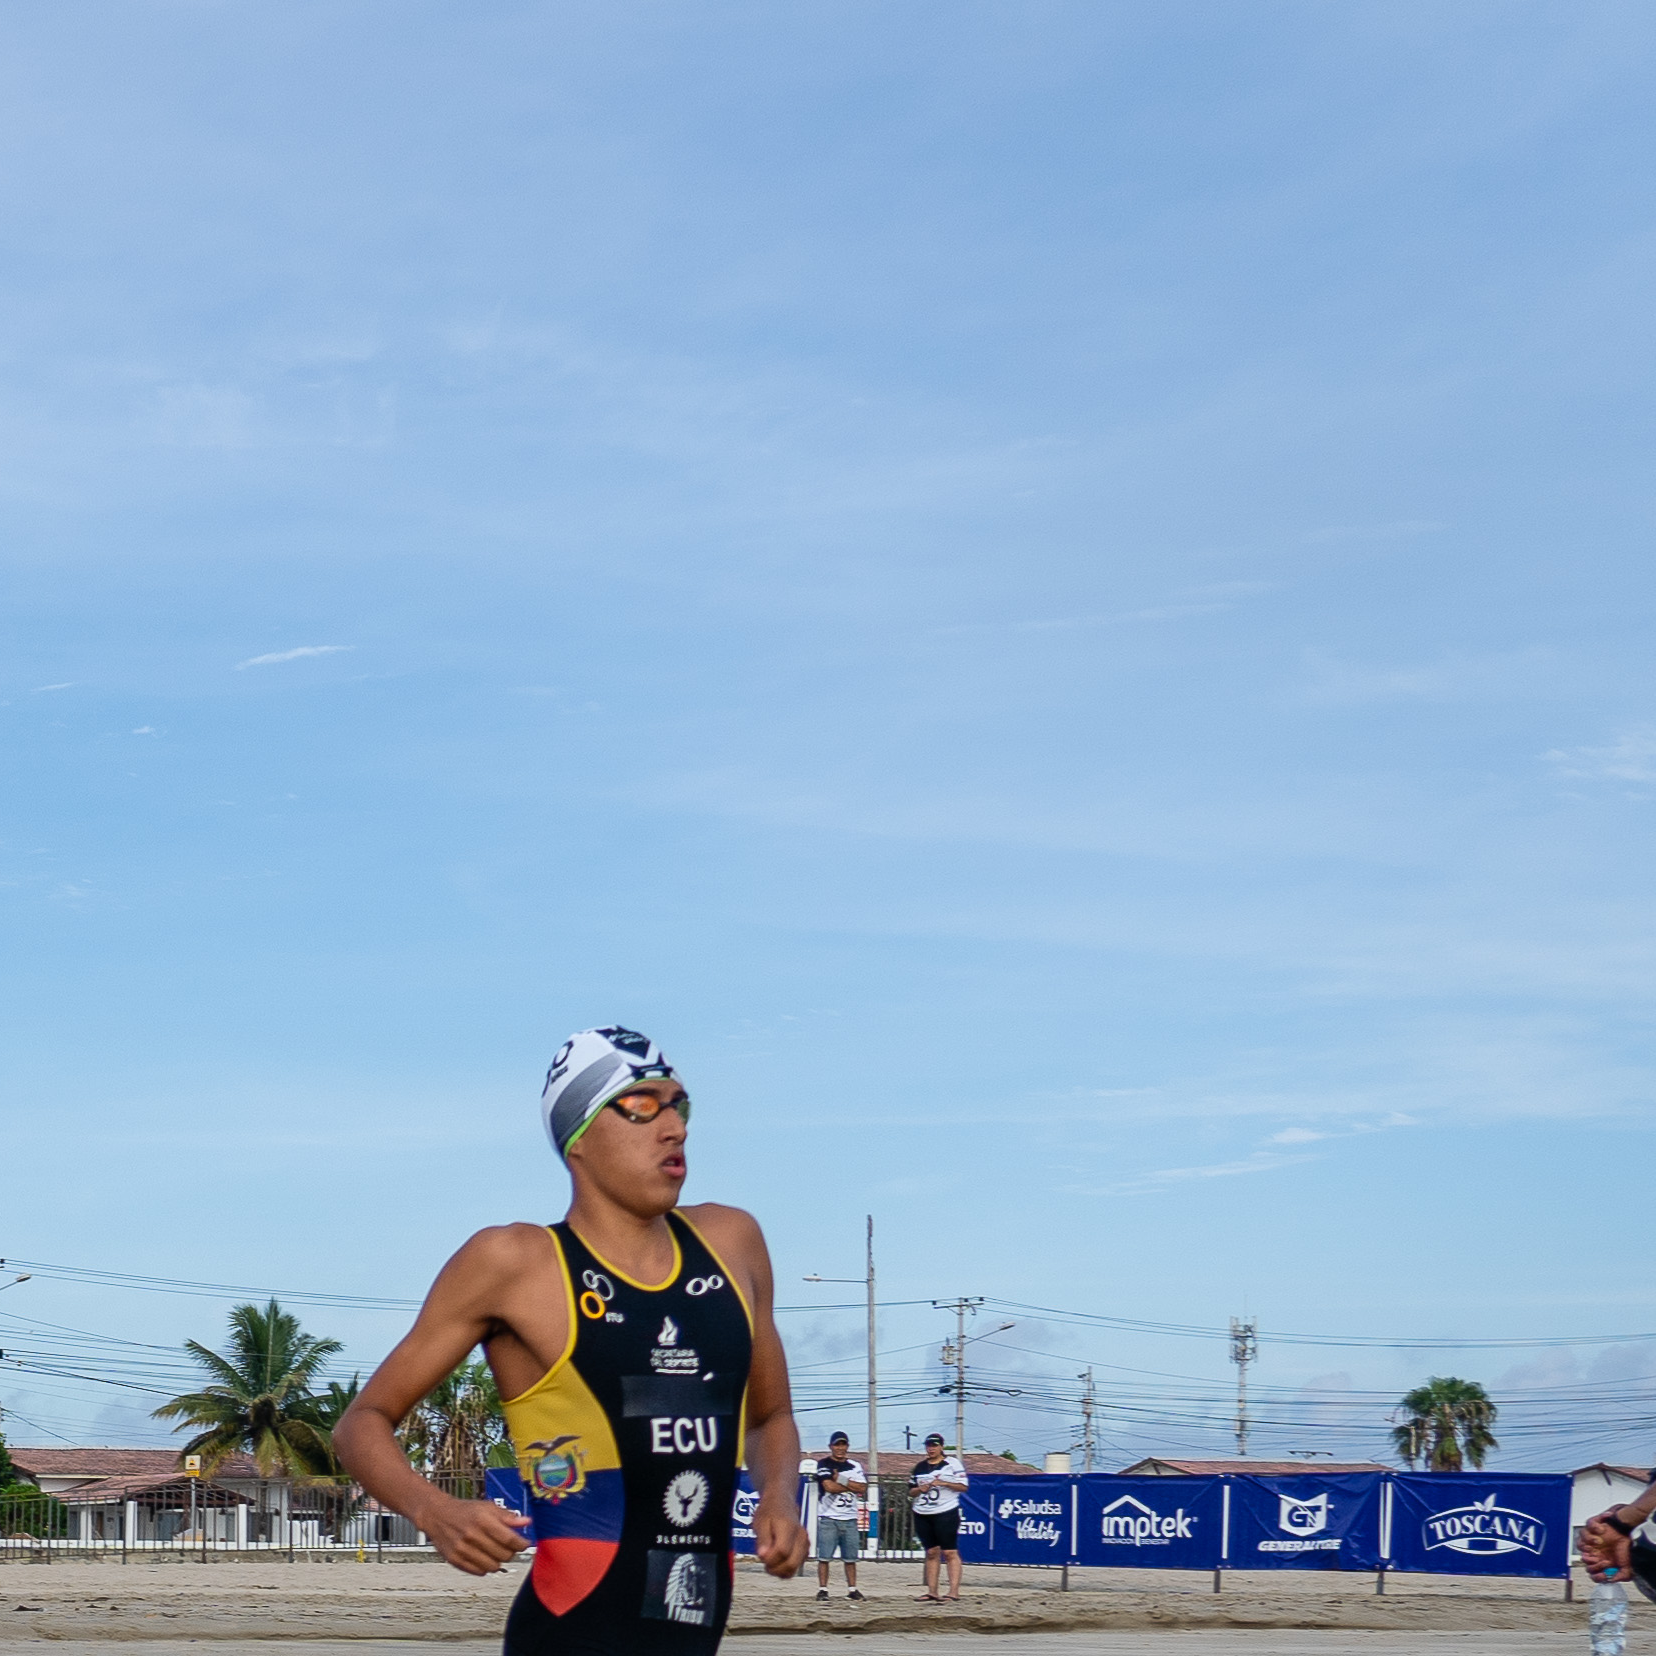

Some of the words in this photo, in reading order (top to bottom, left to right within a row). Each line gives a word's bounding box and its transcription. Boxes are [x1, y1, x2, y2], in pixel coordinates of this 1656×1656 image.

[650, 1416, 718, 1453] ECU
[1012, 1499, 1062, 1515] Saludsa
[957, 1521, 986, 1535] ETO
[1015, 1516, 1062, 1547] Vitality
[1101, 1508, 1193, 1547] imptek
[1428, 1514, 1537, 1546] TOSCANA
